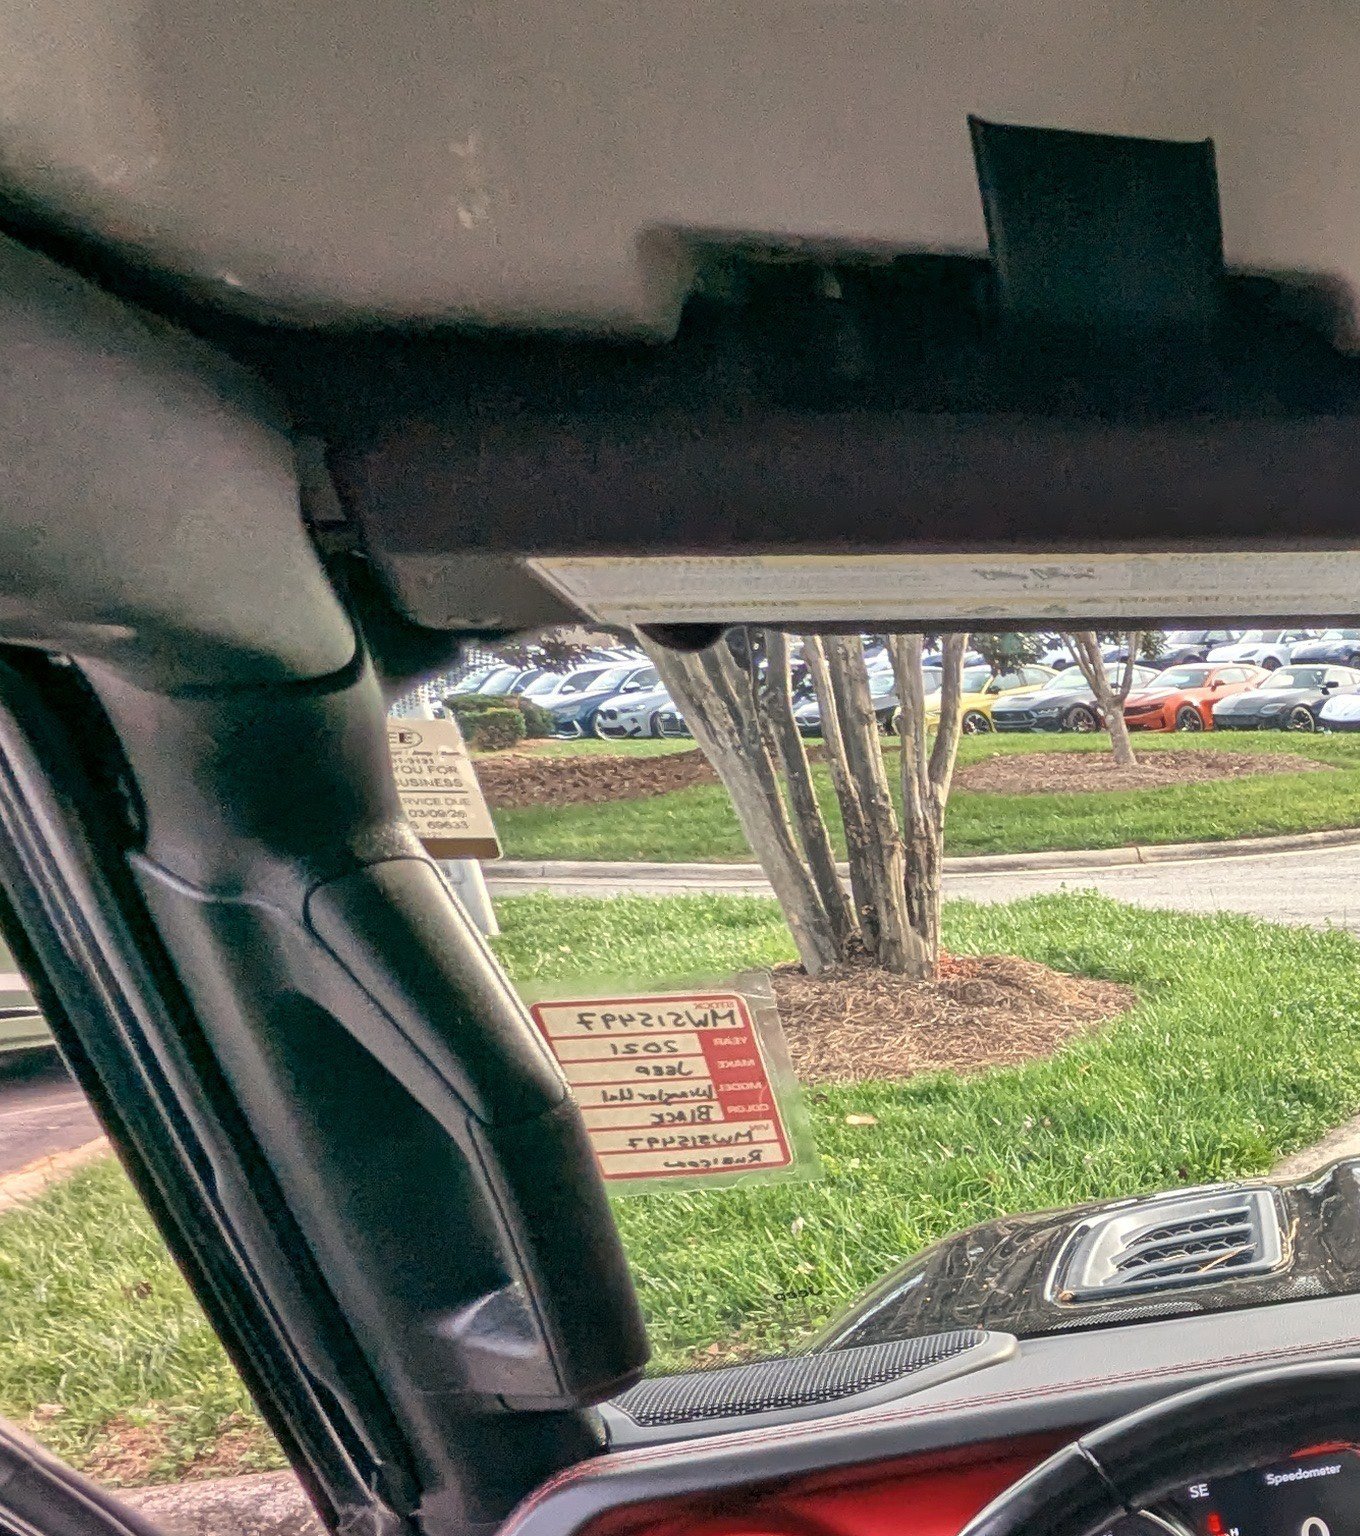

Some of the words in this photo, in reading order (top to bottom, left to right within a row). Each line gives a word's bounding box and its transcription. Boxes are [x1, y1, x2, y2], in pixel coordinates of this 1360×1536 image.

[395, 765, 422, 774] OU
[399, 778, 464, 788] USINESS
[1265, 1464, 1342, 1487] Speedometer
[1189, 1483, 1210, 1499] SE
